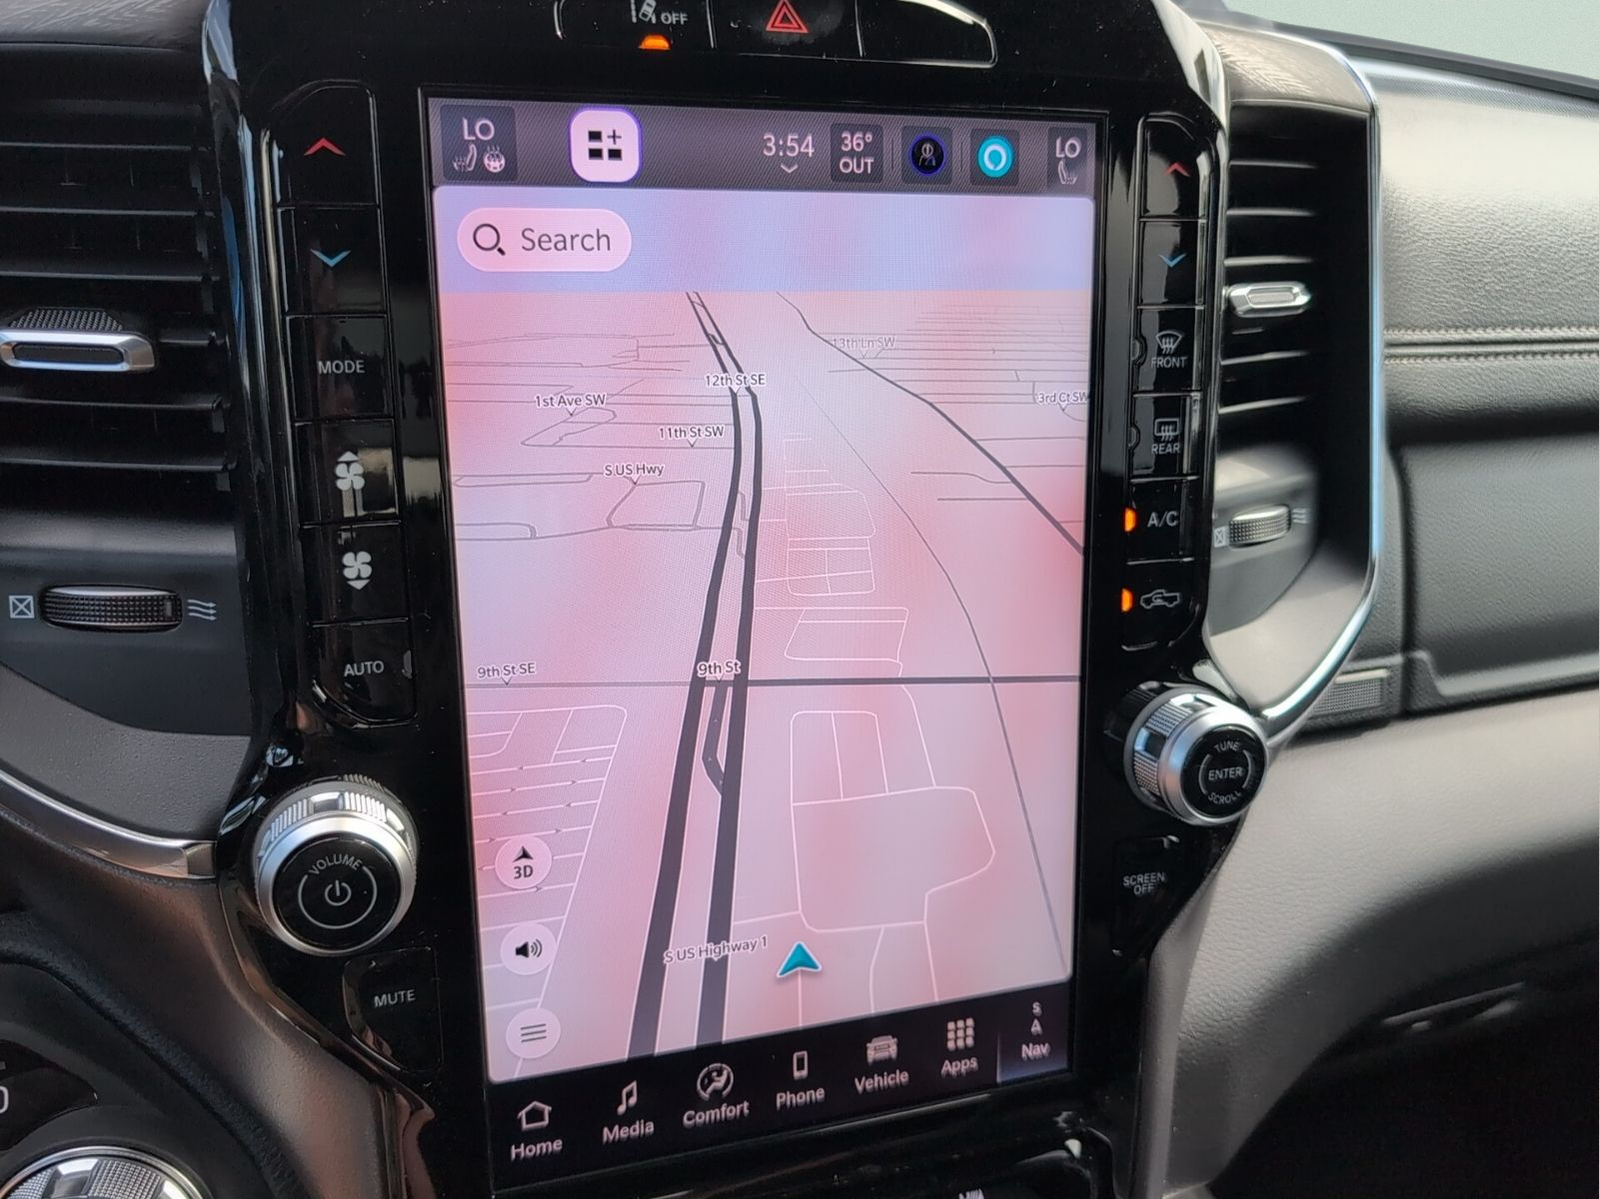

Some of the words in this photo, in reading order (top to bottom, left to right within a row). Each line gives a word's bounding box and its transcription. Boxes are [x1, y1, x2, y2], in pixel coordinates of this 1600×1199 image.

[661, 12, 687, 25] OFF
[462, 117, 495, 140] LO
[763, 132, 815, 157] 3:54
[841, 131, 873, 152] 36°
[1056, 136, 1081, 158] LO
[839, 157, 874, 173] OUT
[521, 228, 612, 253] Search
[833, 337, 858, 349] 13th
[861, 337, 875, 349] Ln
[878, 336, 896, 348] SW
[318, 360, 365, 375] MODE
[1151, 356, 1187, 368] FRONT
[705, 374, 732, 387] 12th
[735, 374, 748, 386] St
[750, 374, 766, 385] SE
[535, 395, 555, 407] 1st
[557, 395, 582, 406] Ave
[584, 394, 606, 406] SW
[1038, 392, 1057, 403] 3rd
[1059, 392, 1070, 403] Ct
[659, 427, 686, 438] 11th
[689, 427, 703, 438] St
[704, 426, 724, 437] SW
[1151, 443, 1180, 454] REAR
[604, 465, 613, 477] S
[615, 465, 633, 476] US
[636, 464, 664, 477] Hwy
[1147, 510, 1179, 528] A/C
[344, 660, 385, 676] AUTO
[477, 665, 500, 678] 9th
[503, 664, 516, 677] St
[519, 662, 535, 674] SE
[698, 662, 722, 676] 9th
[725, 660, 740, 674] St
[1214, 740, 1240, 752] TUNE
[1208, 767, 1243, 781] ENTER
[1208, 789, 1241, 805] SCROLL
[308, 853, 363, 876] VOLUME
[513, 865, 534, 879] 3D
[1122, 871, 1166, 888] SCREEN
[1133, 883, 1155, 895] OFF
[665, 950, 674, 963] S
[677, 947, 695, 961] US
[698, 939, 757, 959] Highway
[761, 935, 767, 947] 1
[374, 989, 416, 1008] MUTE
[1021, 1042, 1051, 1061] Nav
[940, 1057, 979, 1078] Apps
[854, 1069, 909, 1094] Vehicle
[776, 1085, 826, 1110] Phone
[682, 1100, 750, 1129] Comfort
[602, 1119, 655, 1143] Media
[510, 1137, 563, 1161] Home
